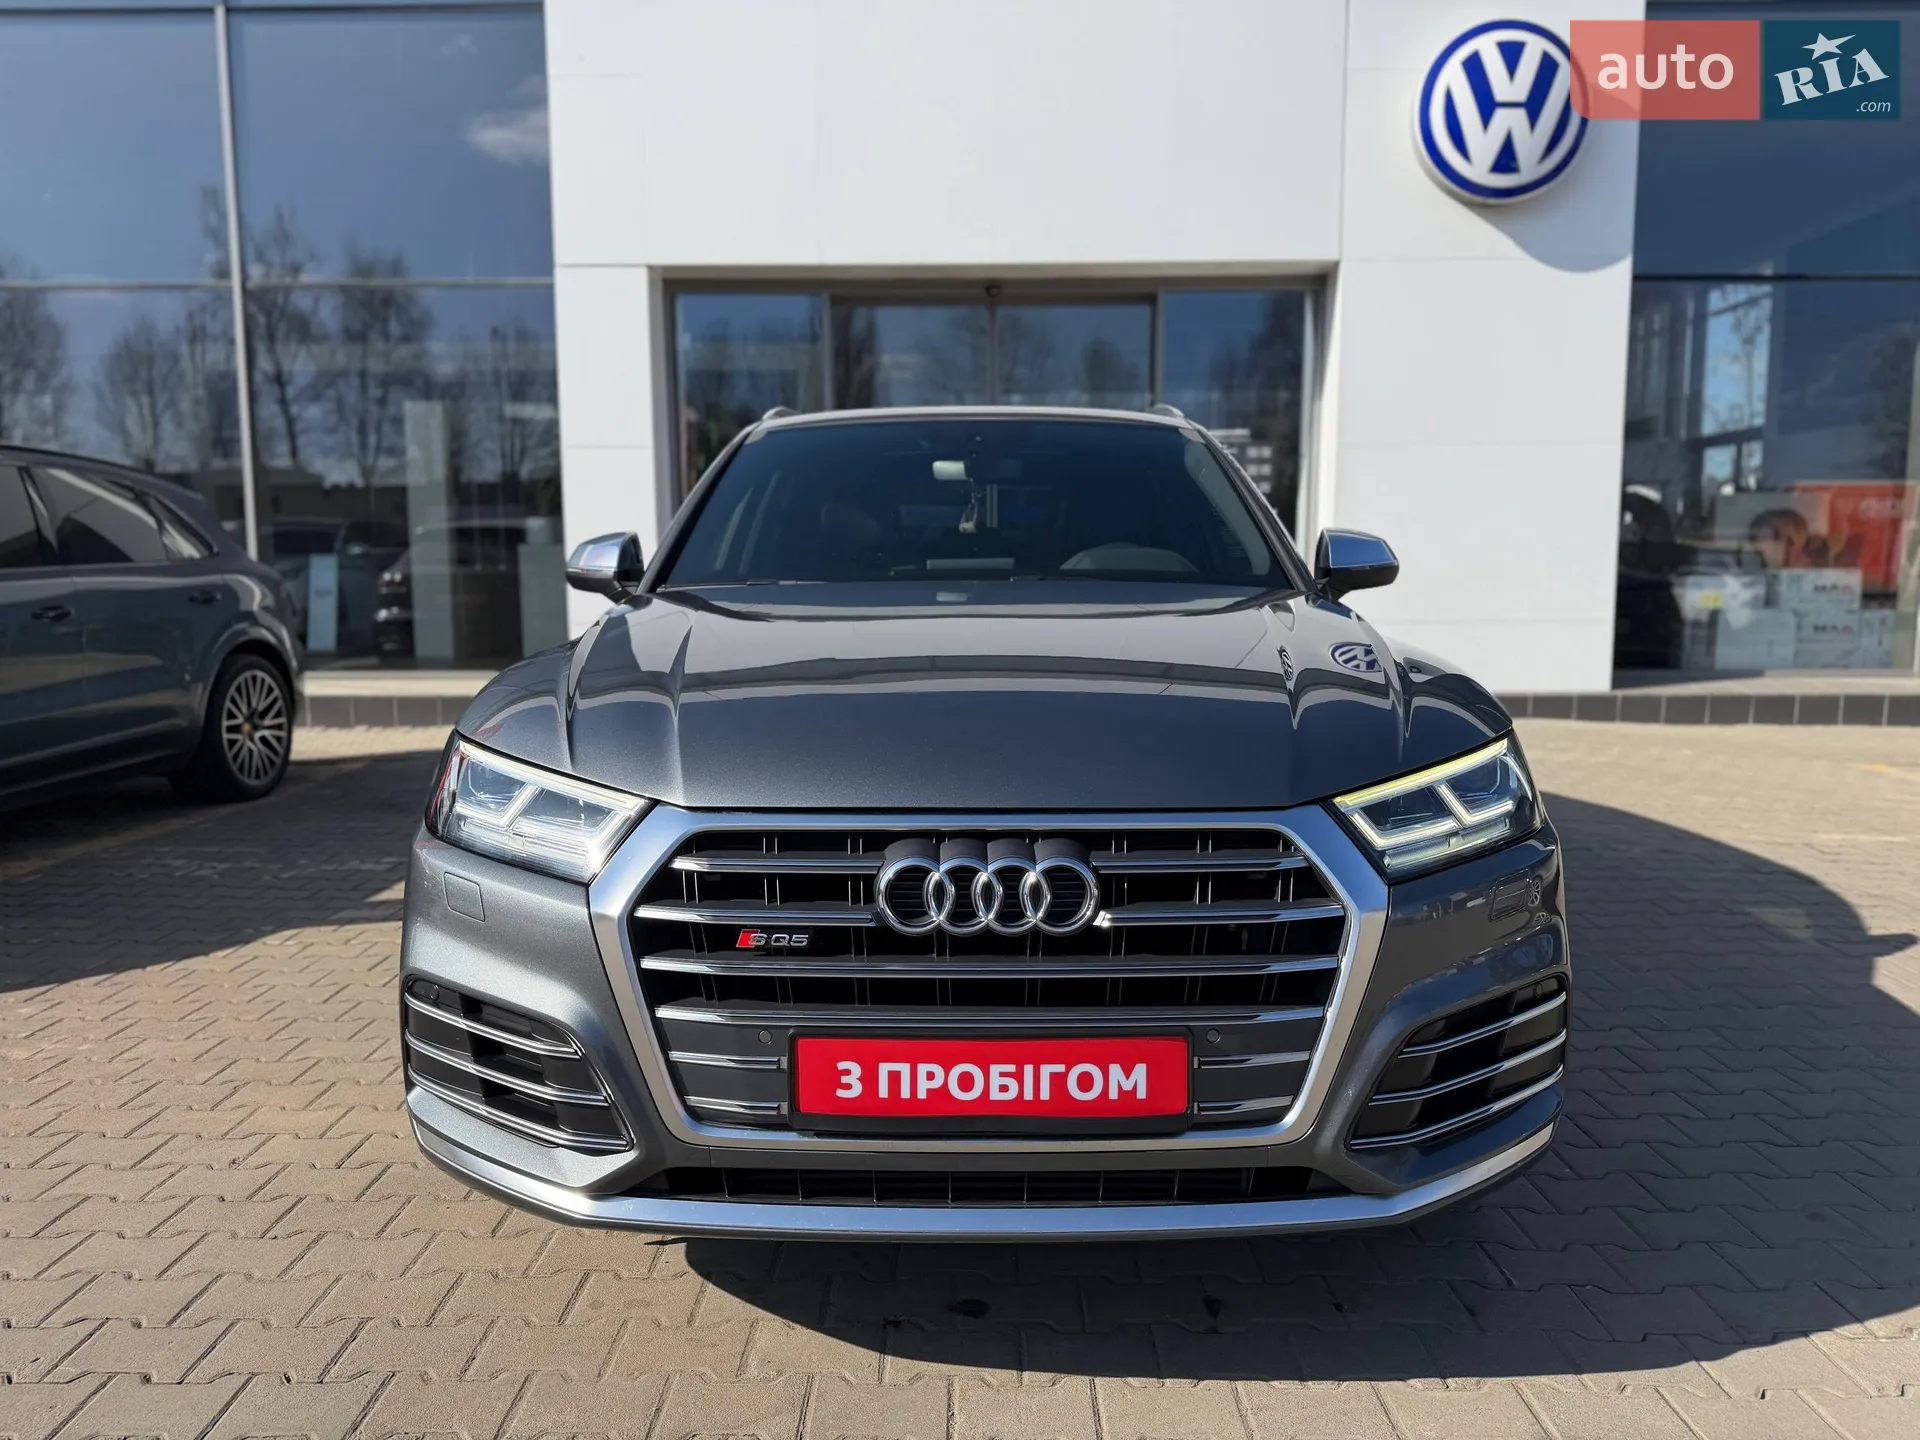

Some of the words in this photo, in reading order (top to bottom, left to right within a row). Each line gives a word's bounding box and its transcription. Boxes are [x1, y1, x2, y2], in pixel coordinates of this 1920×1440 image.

[748, 933, 809, 947] SQ5
[834, 1060, 864, 1099] З
[878, 1062, 1148, 1101] ПРОБІГОМ
